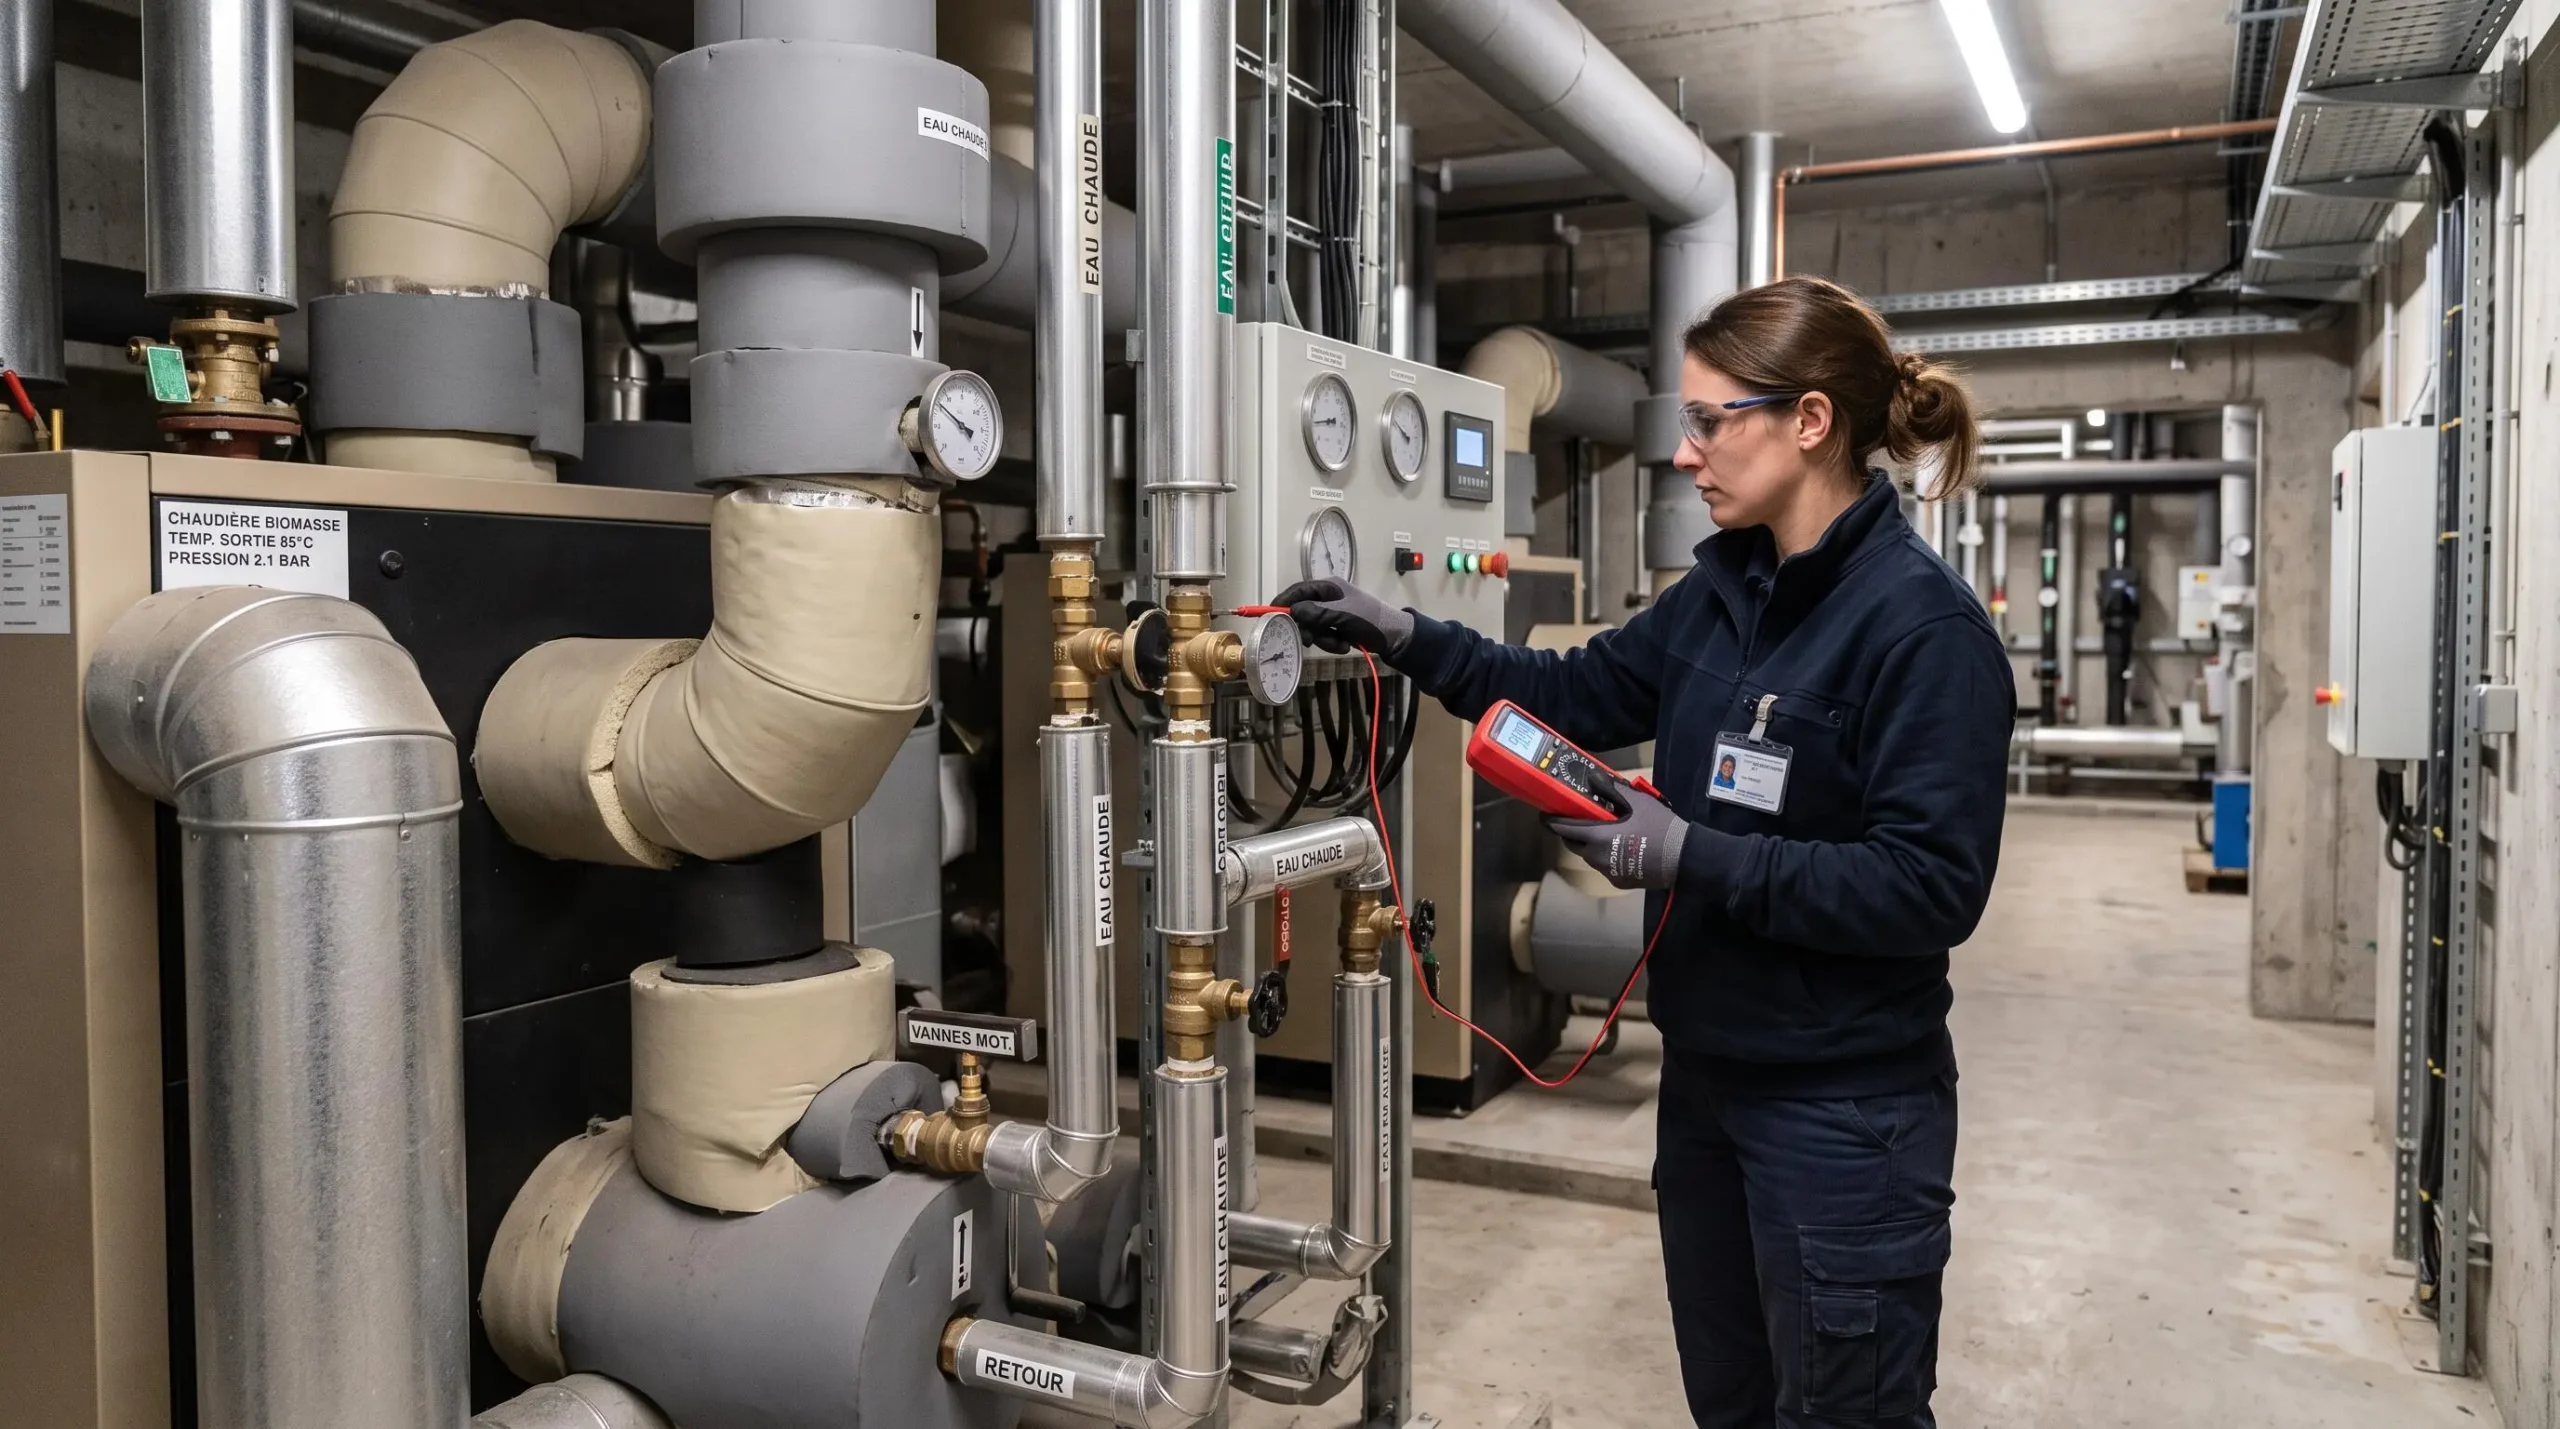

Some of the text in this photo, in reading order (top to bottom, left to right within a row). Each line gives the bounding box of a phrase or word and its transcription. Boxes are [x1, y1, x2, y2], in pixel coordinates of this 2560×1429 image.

[923, 116, 948, 133] EAU
[1083, 123, 1099, 286] EAU CHAUDE
[168, 510, 341, 532] CHAUDIÈRE BIOMASSE
[168, 531, 314, 549] TEMP. SORTIE 85°C
[168, 551, 311, 568] PRESSION 2.1 BAR
[1098, 801, 1112, 940] EAU CHAUDE
[1276, 844, 1343, 876] EAU CHAUDE
[912, 1024, 1012, 1050] VANNES MOT.
[1217, 1142, 1228, 1308] EAU CHAUDE
[984, 1356, 1063, 1393] RETOUR
